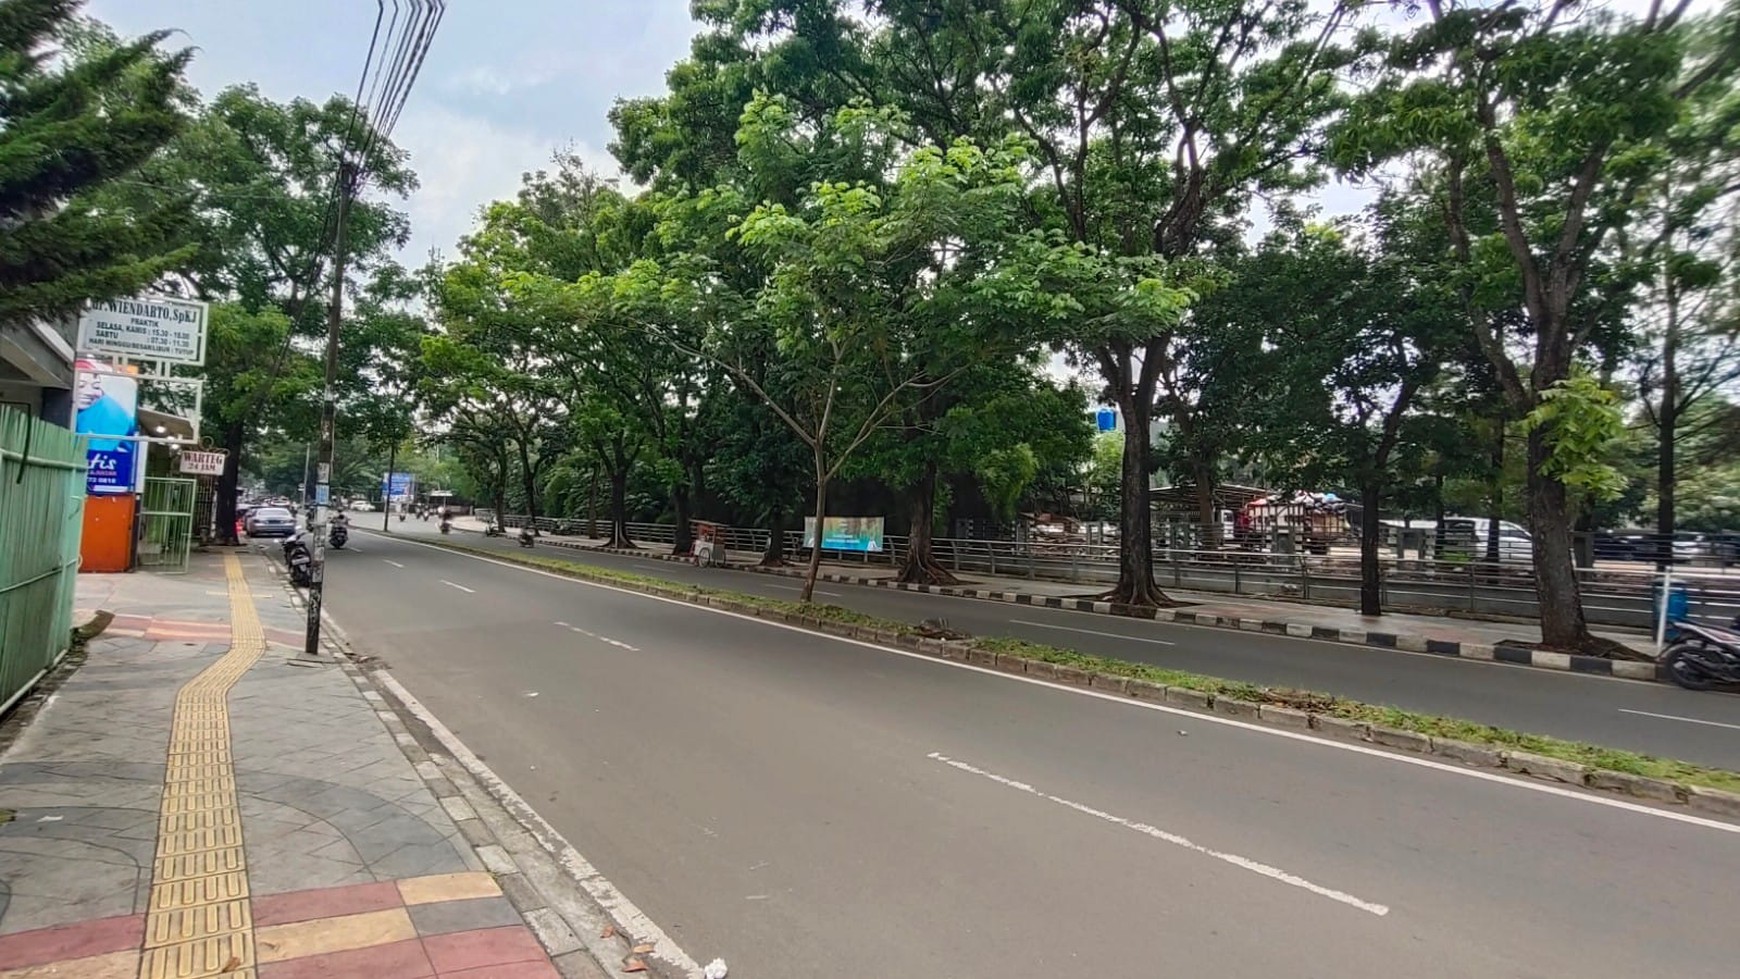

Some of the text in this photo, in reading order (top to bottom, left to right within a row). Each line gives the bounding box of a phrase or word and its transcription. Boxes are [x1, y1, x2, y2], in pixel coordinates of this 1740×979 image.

[131, 318, 160, 328] PRAKTIK
[96, 330, 119, 339] SABTU
[126, 325, 147, 335] KAMIS
[89, 338, 105, 346] HARI
[174, 347, 195, 356] TUTUP
[88, 453, 117, 470] tis
[184, 452, 222, 465] WARTEG
[201, 463, 216, 471] JAM
